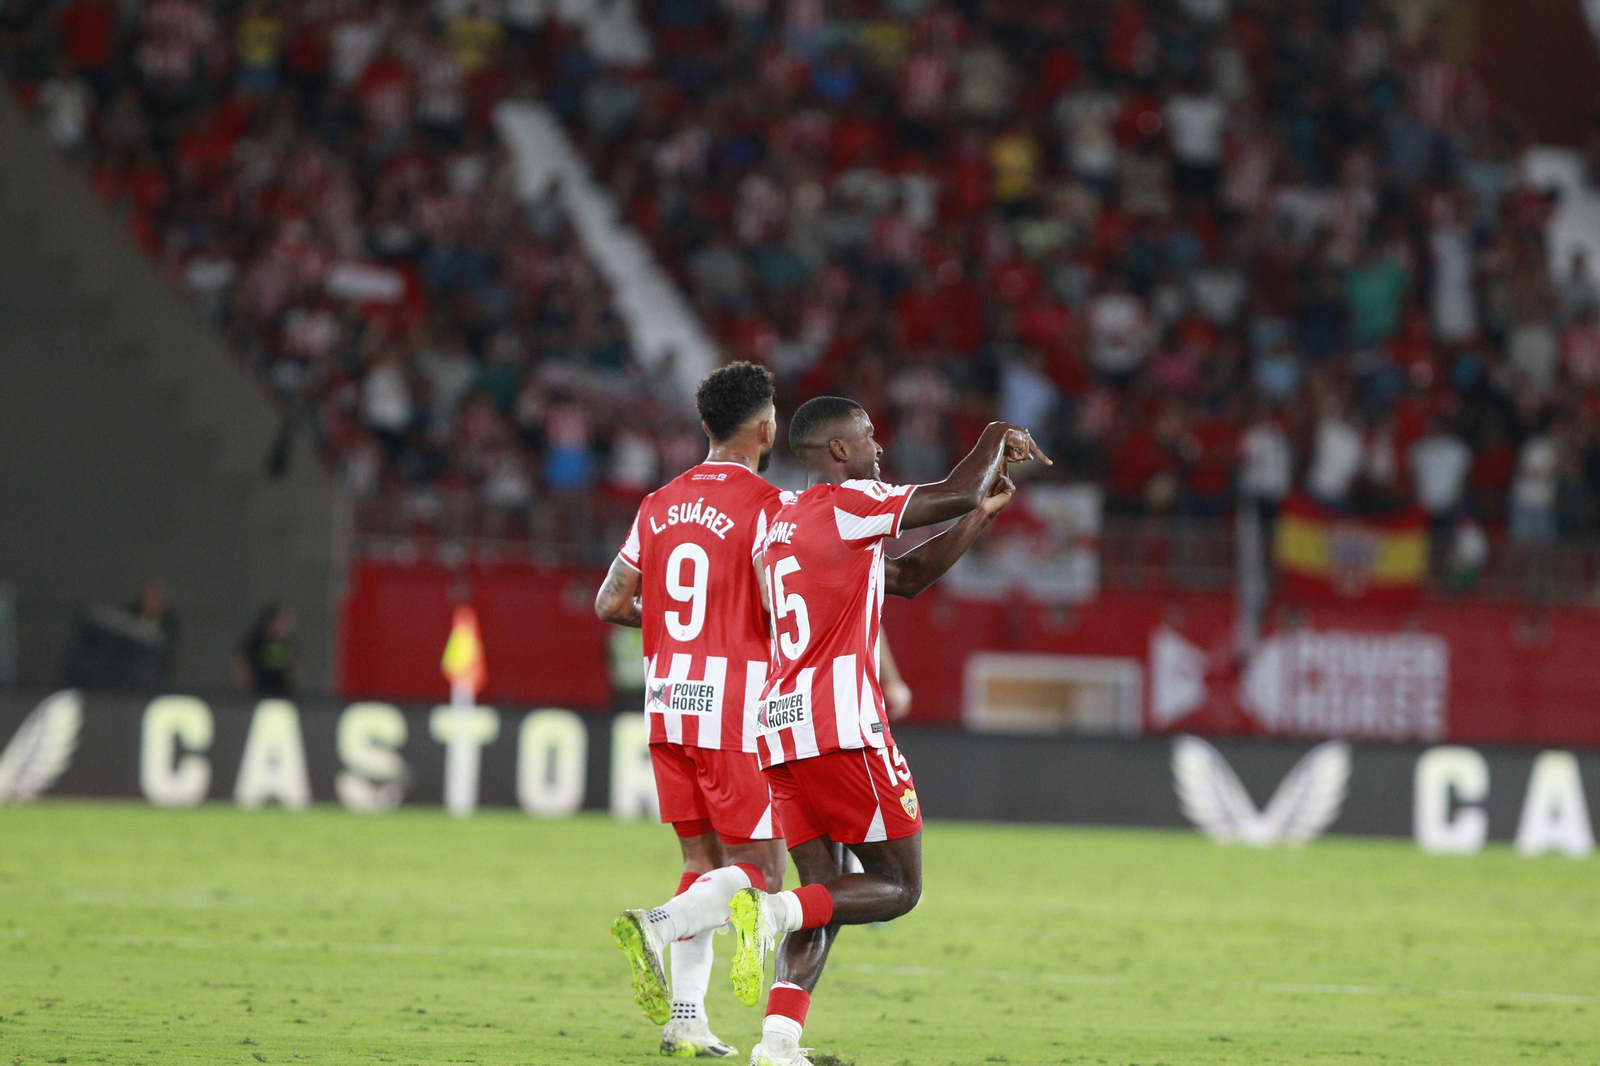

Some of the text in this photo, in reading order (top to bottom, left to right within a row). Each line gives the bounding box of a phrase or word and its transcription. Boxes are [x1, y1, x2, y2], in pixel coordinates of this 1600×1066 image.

[650, 497, 735, 540] L. SUÁREZ
[665, 542, 710, 642] 9
[672, 697, 713, 712] HORSE
[673, 683, 715, 698] POWER
[769, 694, 803, 714] POWER
[769, 707, 804, 728] HORSE
[877, 745, 911, 787] 15
[1412, 745, 1596, 859] CA
